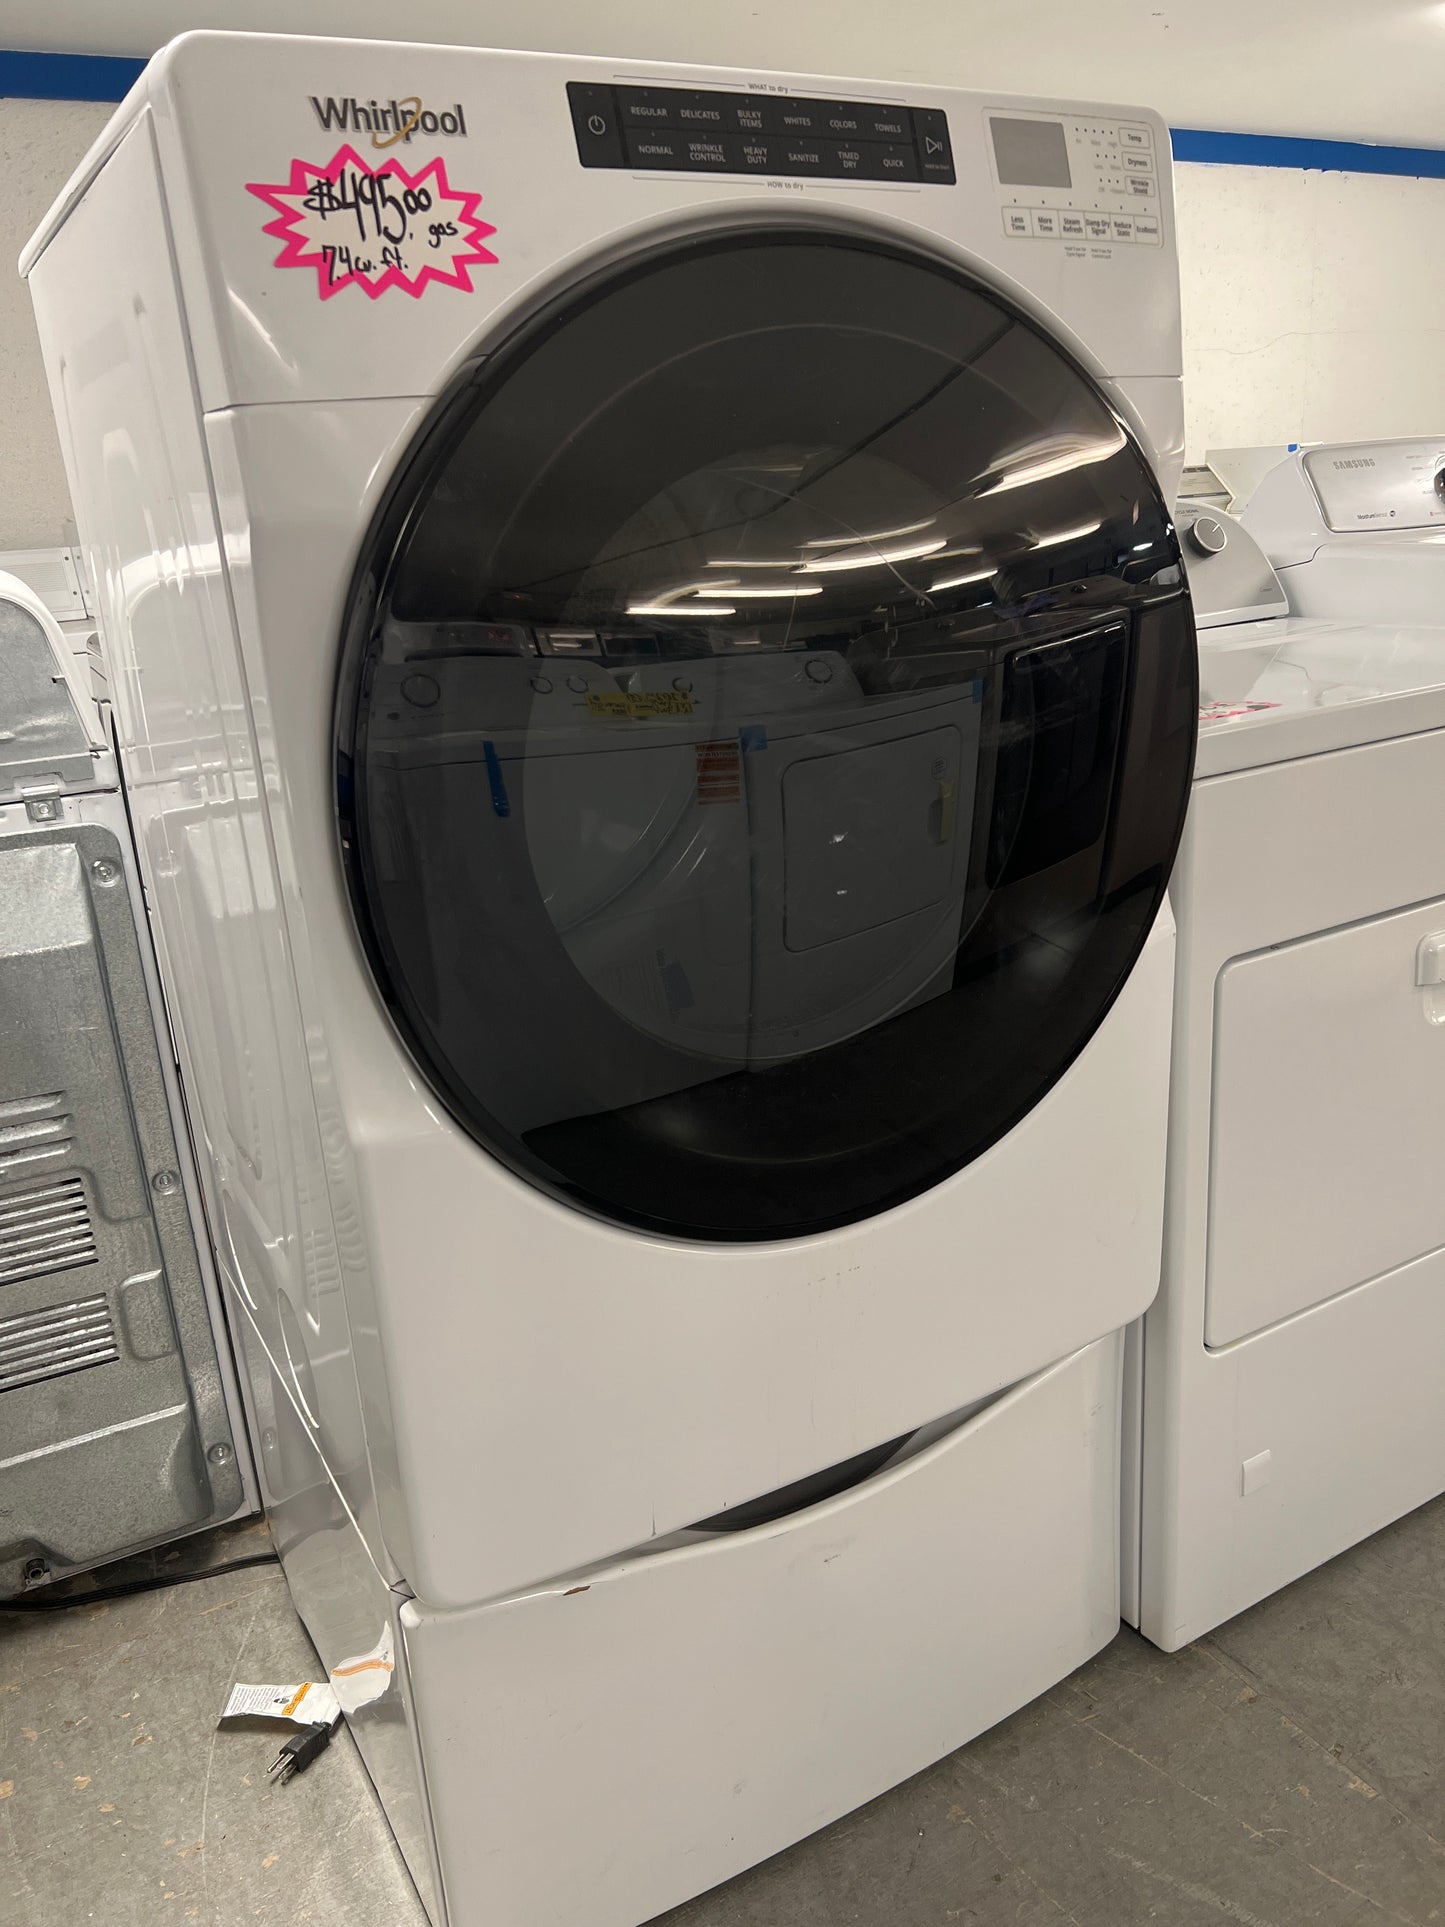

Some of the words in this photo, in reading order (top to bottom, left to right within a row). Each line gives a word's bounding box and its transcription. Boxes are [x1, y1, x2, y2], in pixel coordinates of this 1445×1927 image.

[747, 82, 767, 90] WHAT
[777, 85, 789, 94] dry
[630, 105, 669, 118] REGULAR
[680, 109, 721, 121] DELICATES
[736, 109, 762, 119] BULKY
[309, 96, 467, 145] Whirlpool
[738, 118, 763, 129] ITEMS
[783, 116, 812, 127] WHITES
[829, 118, 858, 130] COLORS
[874, 122, 902, 134] TOWELS
[1127, 133, 1142, 143] Temp
[638, 144, 674, 156] NORMAL
[688, 142, 724, 153] WRINKLE
[743, 145, 768, 156] HEAVY
[689, 151, 726, 163] CONTROL
[746, 154, 767, 165] DUTY
[788, 152, 820, 164] SANITIZE
[838, 151, 860, 161] TIMED
[843, 159, 858, 170] DRY
[883, 158, 904, 168] QUICK
[767, 181, 785, 189] HOW
[793, 182, 804, 190] dry
[1010, 215, 1024, 224] Less
[1037, 216, 1053, 225] More
[1011, 223, 1026, 232] Time
[1039, 224, 1053, 233] Time
[428, 221, 458, 248] gas
[380, 247, 408, 270] ft.
[1333, 457, 1376, 471] SAMSUNG
